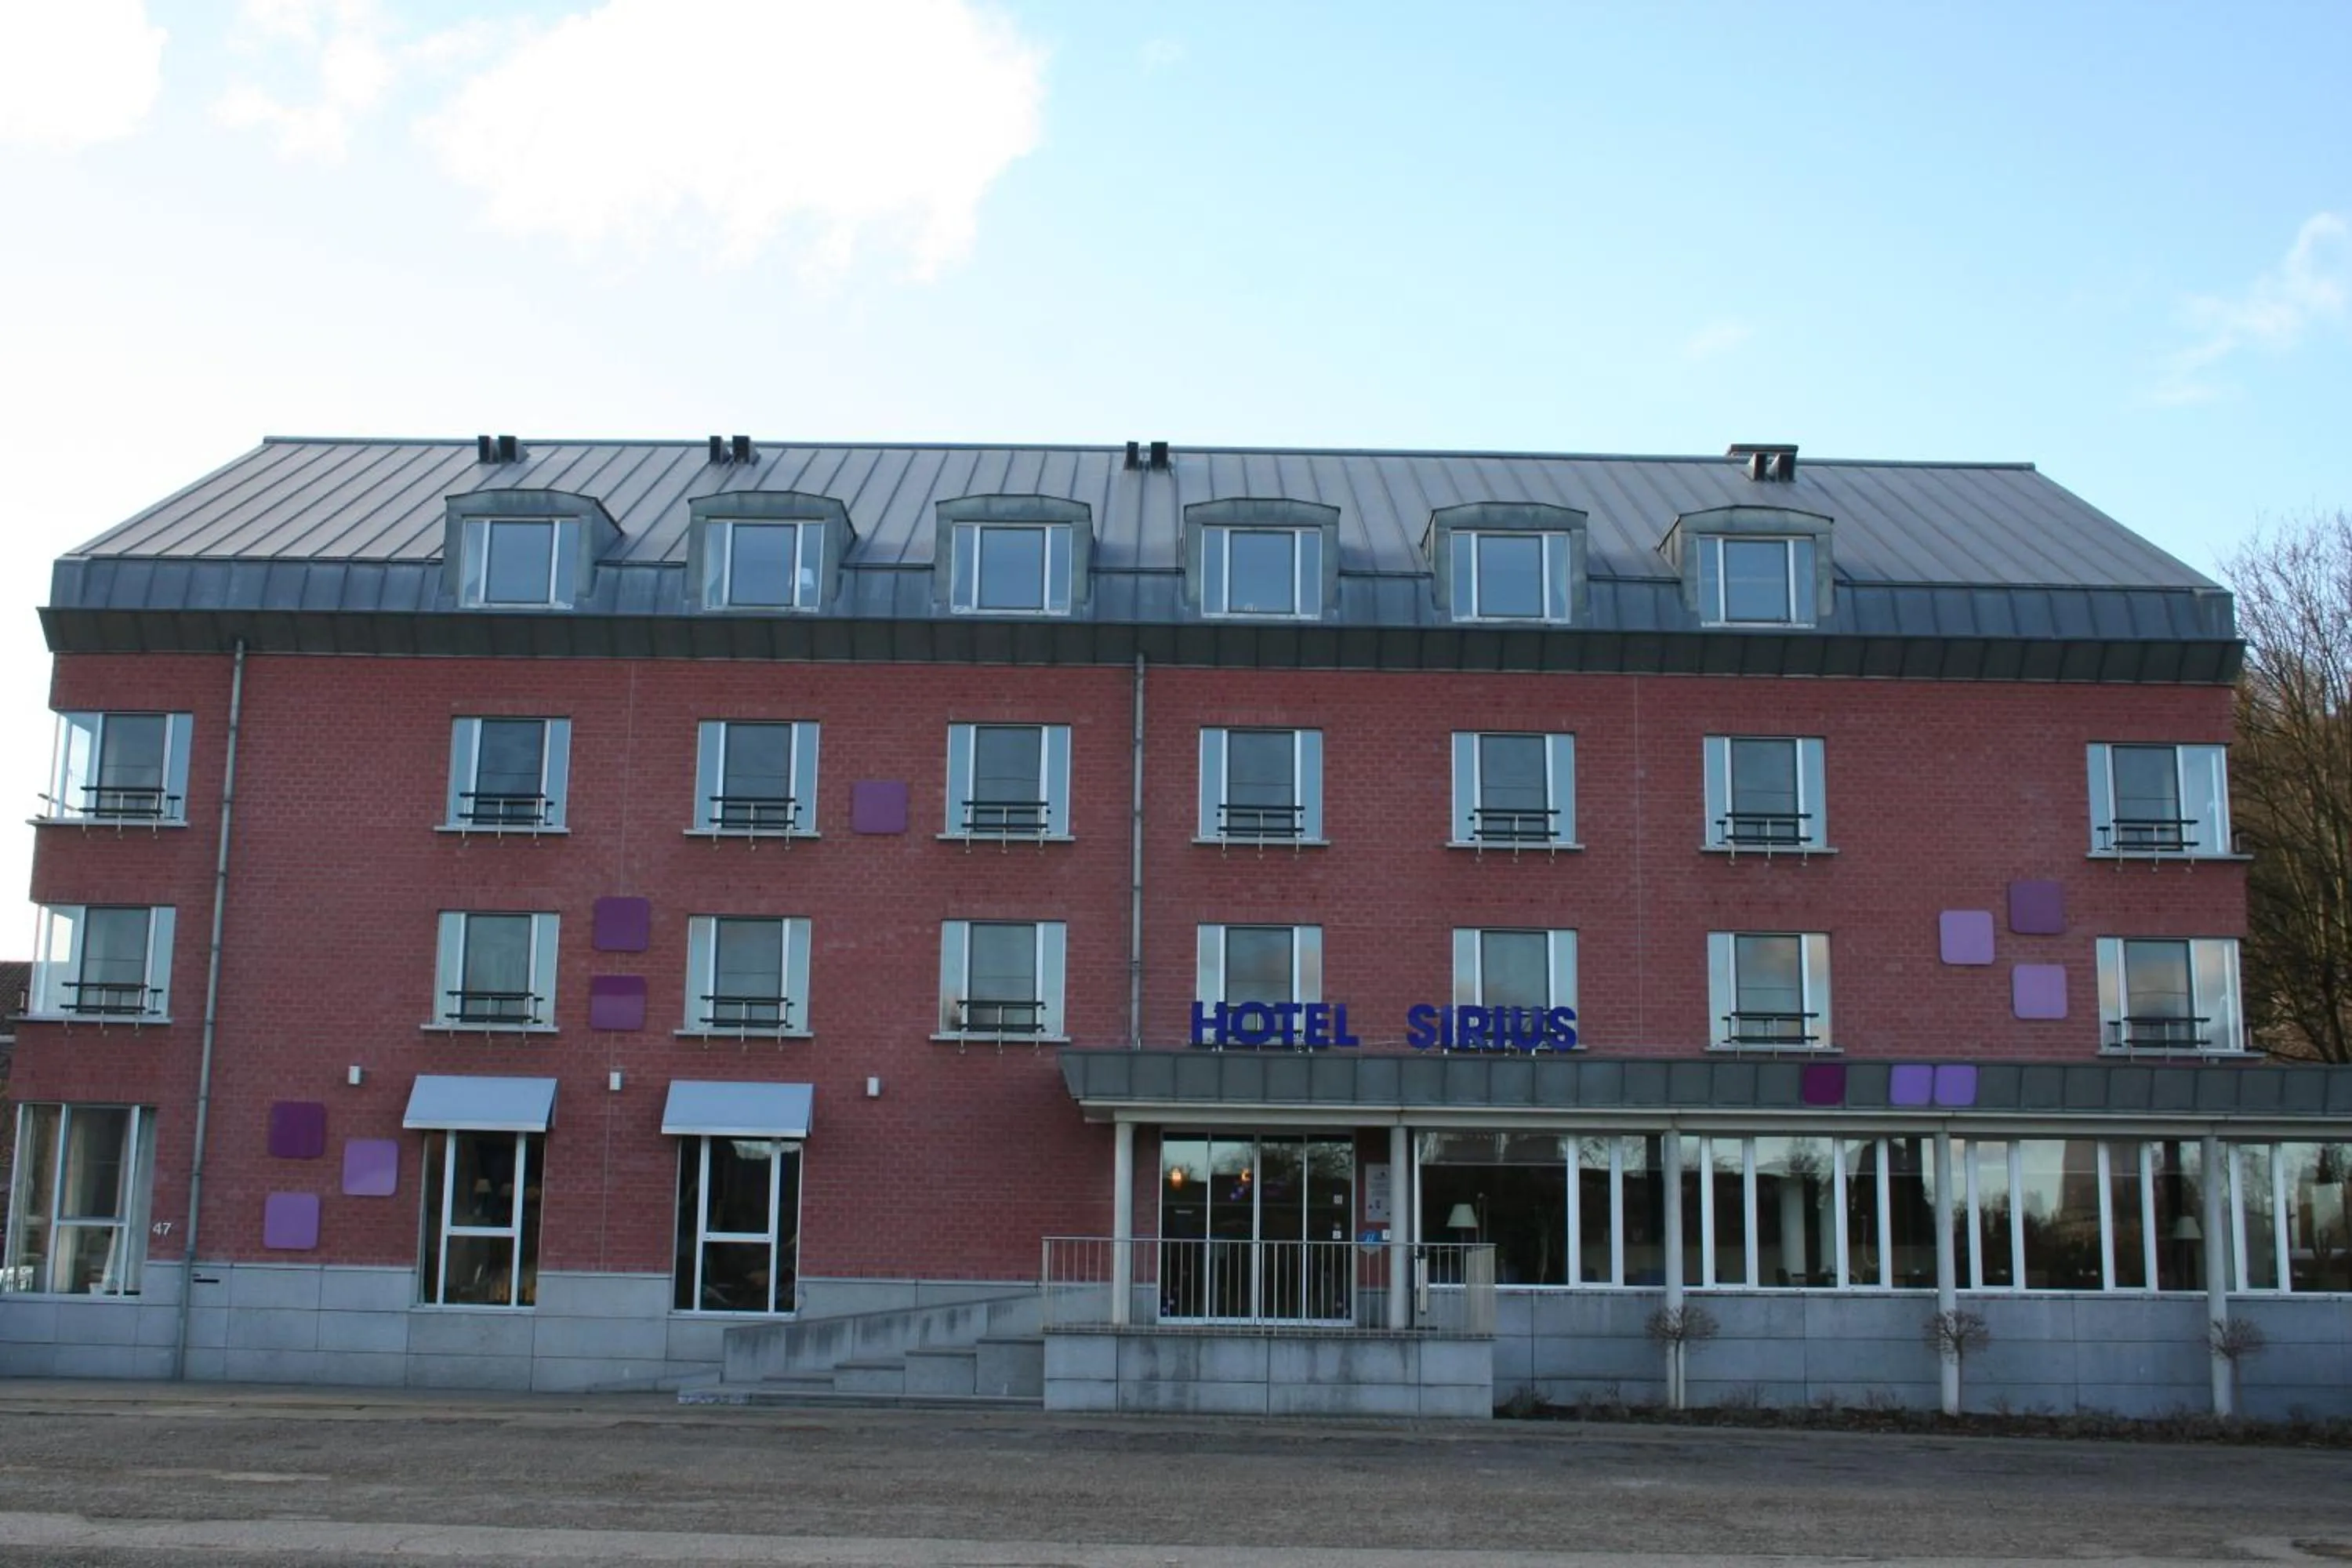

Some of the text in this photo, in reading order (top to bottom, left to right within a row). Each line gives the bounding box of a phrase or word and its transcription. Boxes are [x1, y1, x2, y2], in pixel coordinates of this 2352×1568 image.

[1191, 1001, 1577, 1051] HOTEL SIRIUS
[153, 1222, 172, 1236] 47
